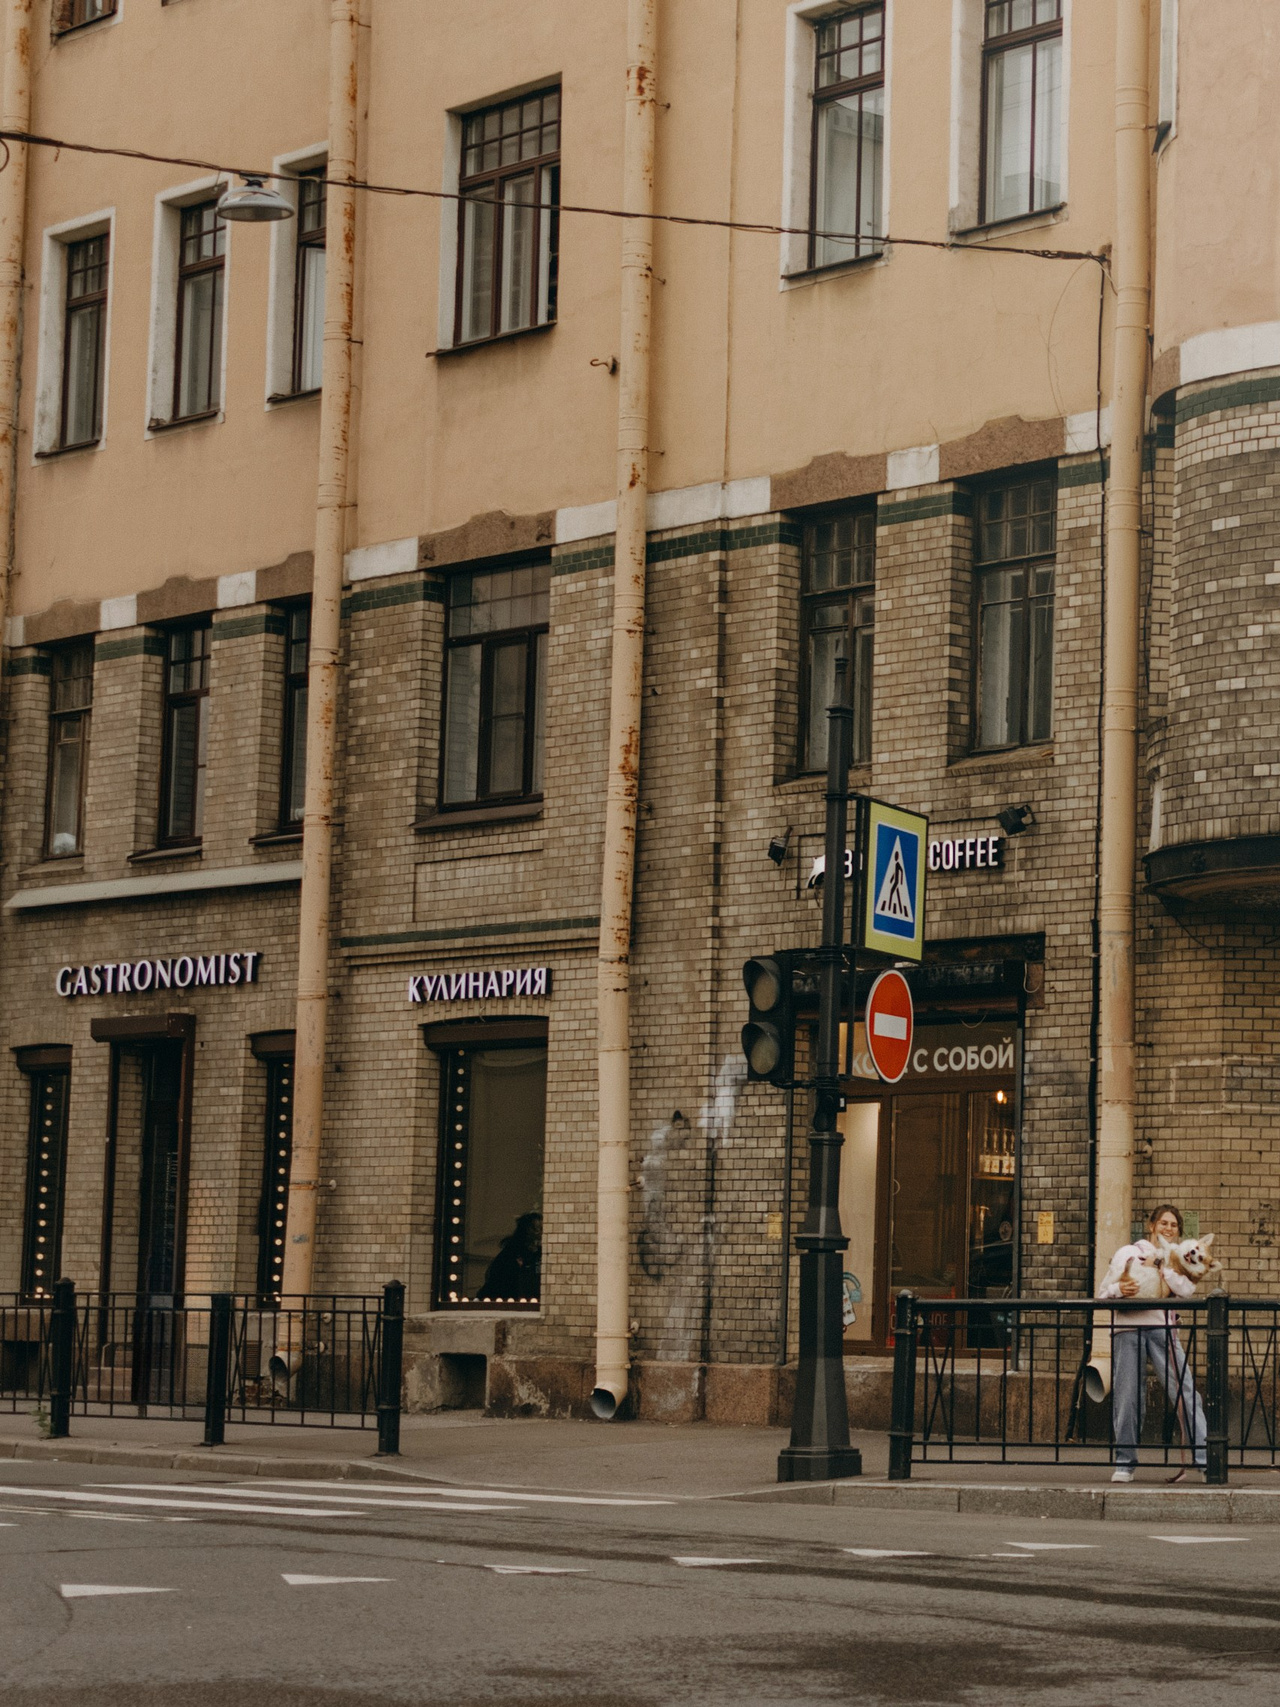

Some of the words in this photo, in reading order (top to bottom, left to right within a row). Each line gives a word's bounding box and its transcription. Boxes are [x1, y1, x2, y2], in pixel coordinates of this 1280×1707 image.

[929, 836, 999, 871] COFFEE
[56, 952, 258, 997] GASTRONOMIST
[408, 967, 547, 1002] КУЛИНАРИЯ
[913, 1048, 928, 1073] С
[933, 1036, 1015, 1071] СОБОЙ
